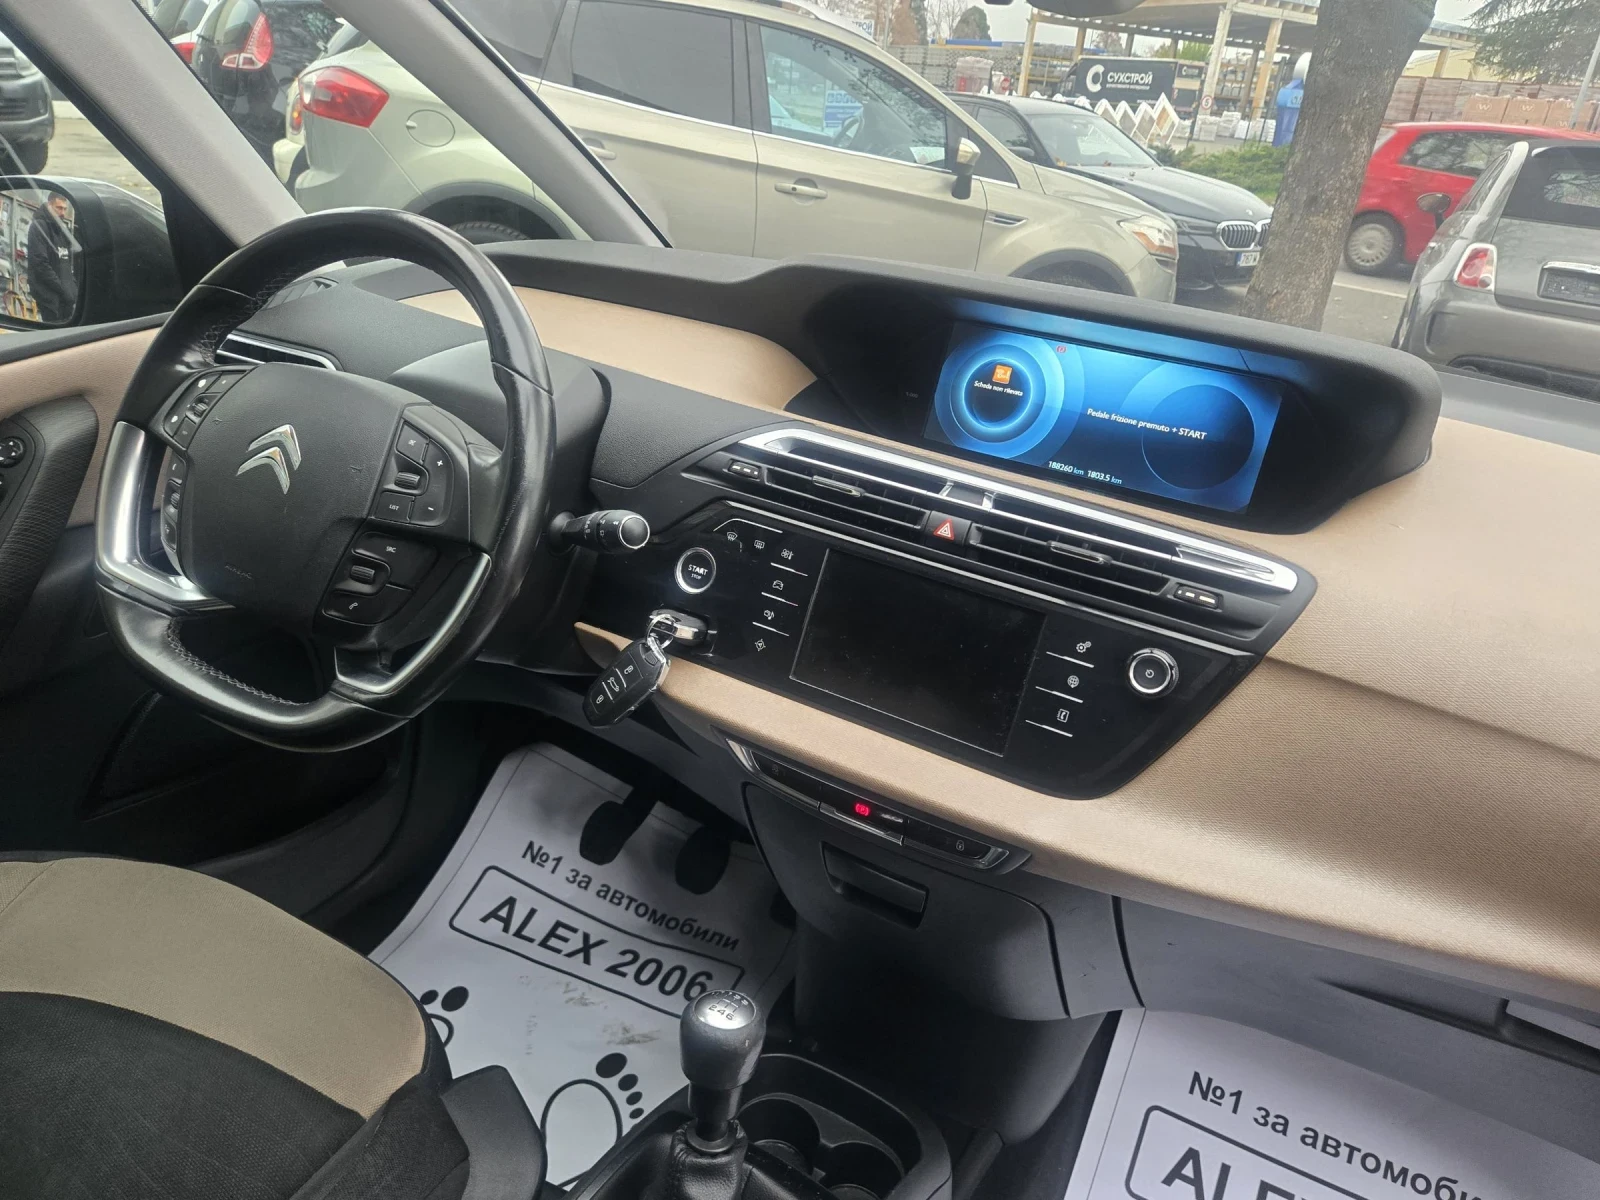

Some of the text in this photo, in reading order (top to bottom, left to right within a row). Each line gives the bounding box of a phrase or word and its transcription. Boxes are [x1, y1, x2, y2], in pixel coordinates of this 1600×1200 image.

[1107, 71, 1152, 84] СУХСТРОЙ
[1087, 408, 1110, 420] Pedale
[1110, 413, 1138, 426] frizione
[1138, 420, 1170, 433] premuto
[1178, 427, 1208, 440] START
[1048, 461, 1123, 485] 188260 km 1803.5 km
[688, 564, 708, 575] START
[521, 839, 740, 952] №1 за автомобили
[479, 895, 714, 1002] ALEX 2006
[1188, 1070, 1243, 1115] №1
[1253, 1106, 1290, 1137] за
